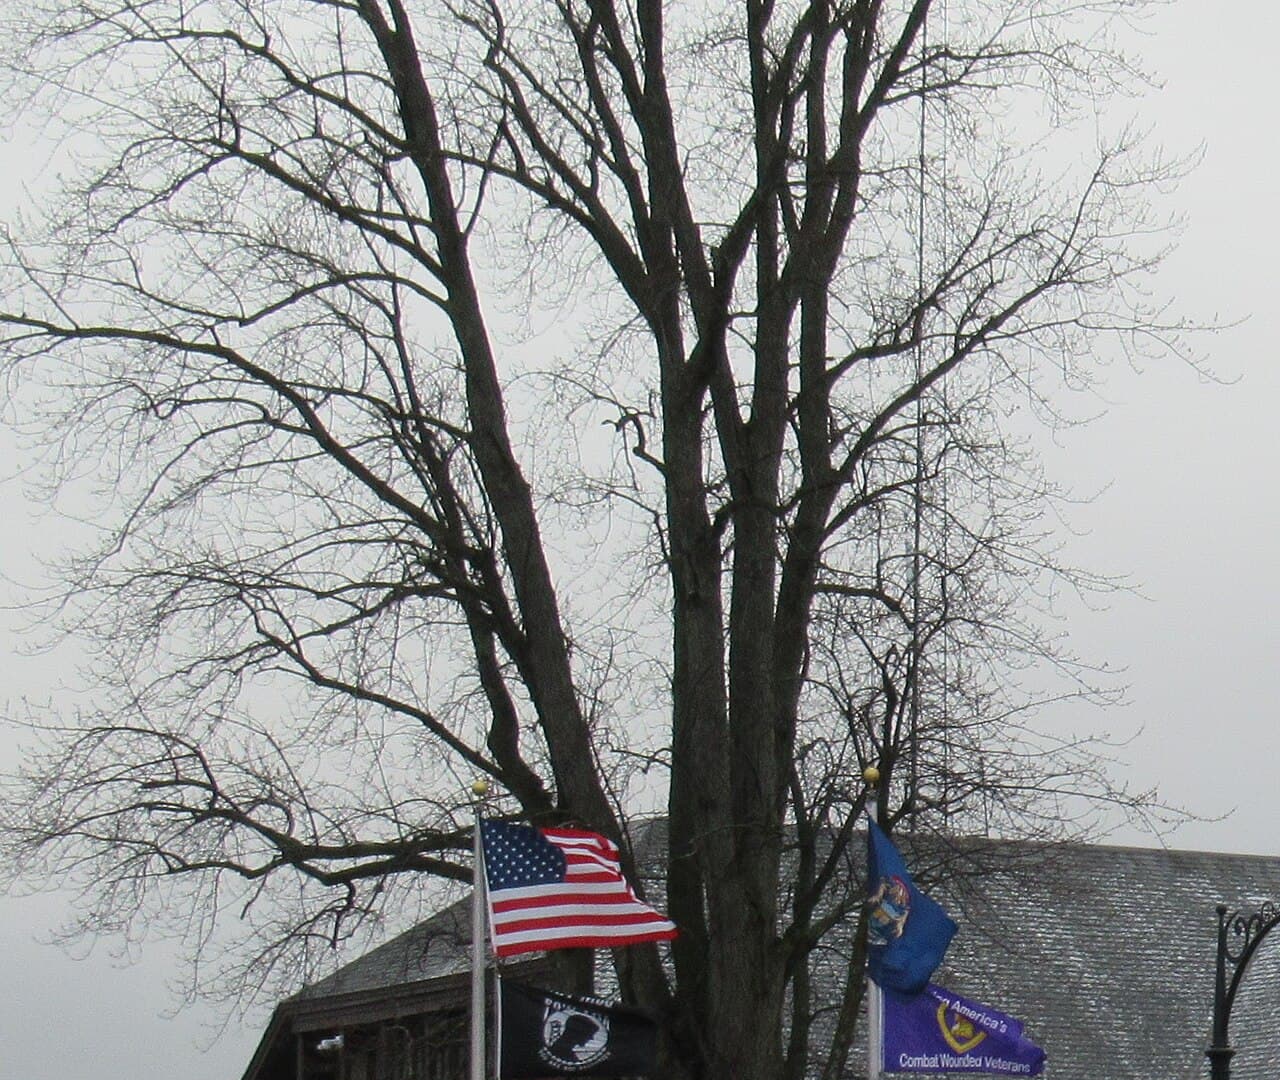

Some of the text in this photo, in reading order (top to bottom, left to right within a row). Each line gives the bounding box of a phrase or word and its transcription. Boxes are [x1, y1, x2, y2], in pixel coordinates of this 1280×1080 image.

[951, 1001, 1008, 1033] America's
[899, 1053, 1031, 1073] Combat Wounded Veterans
